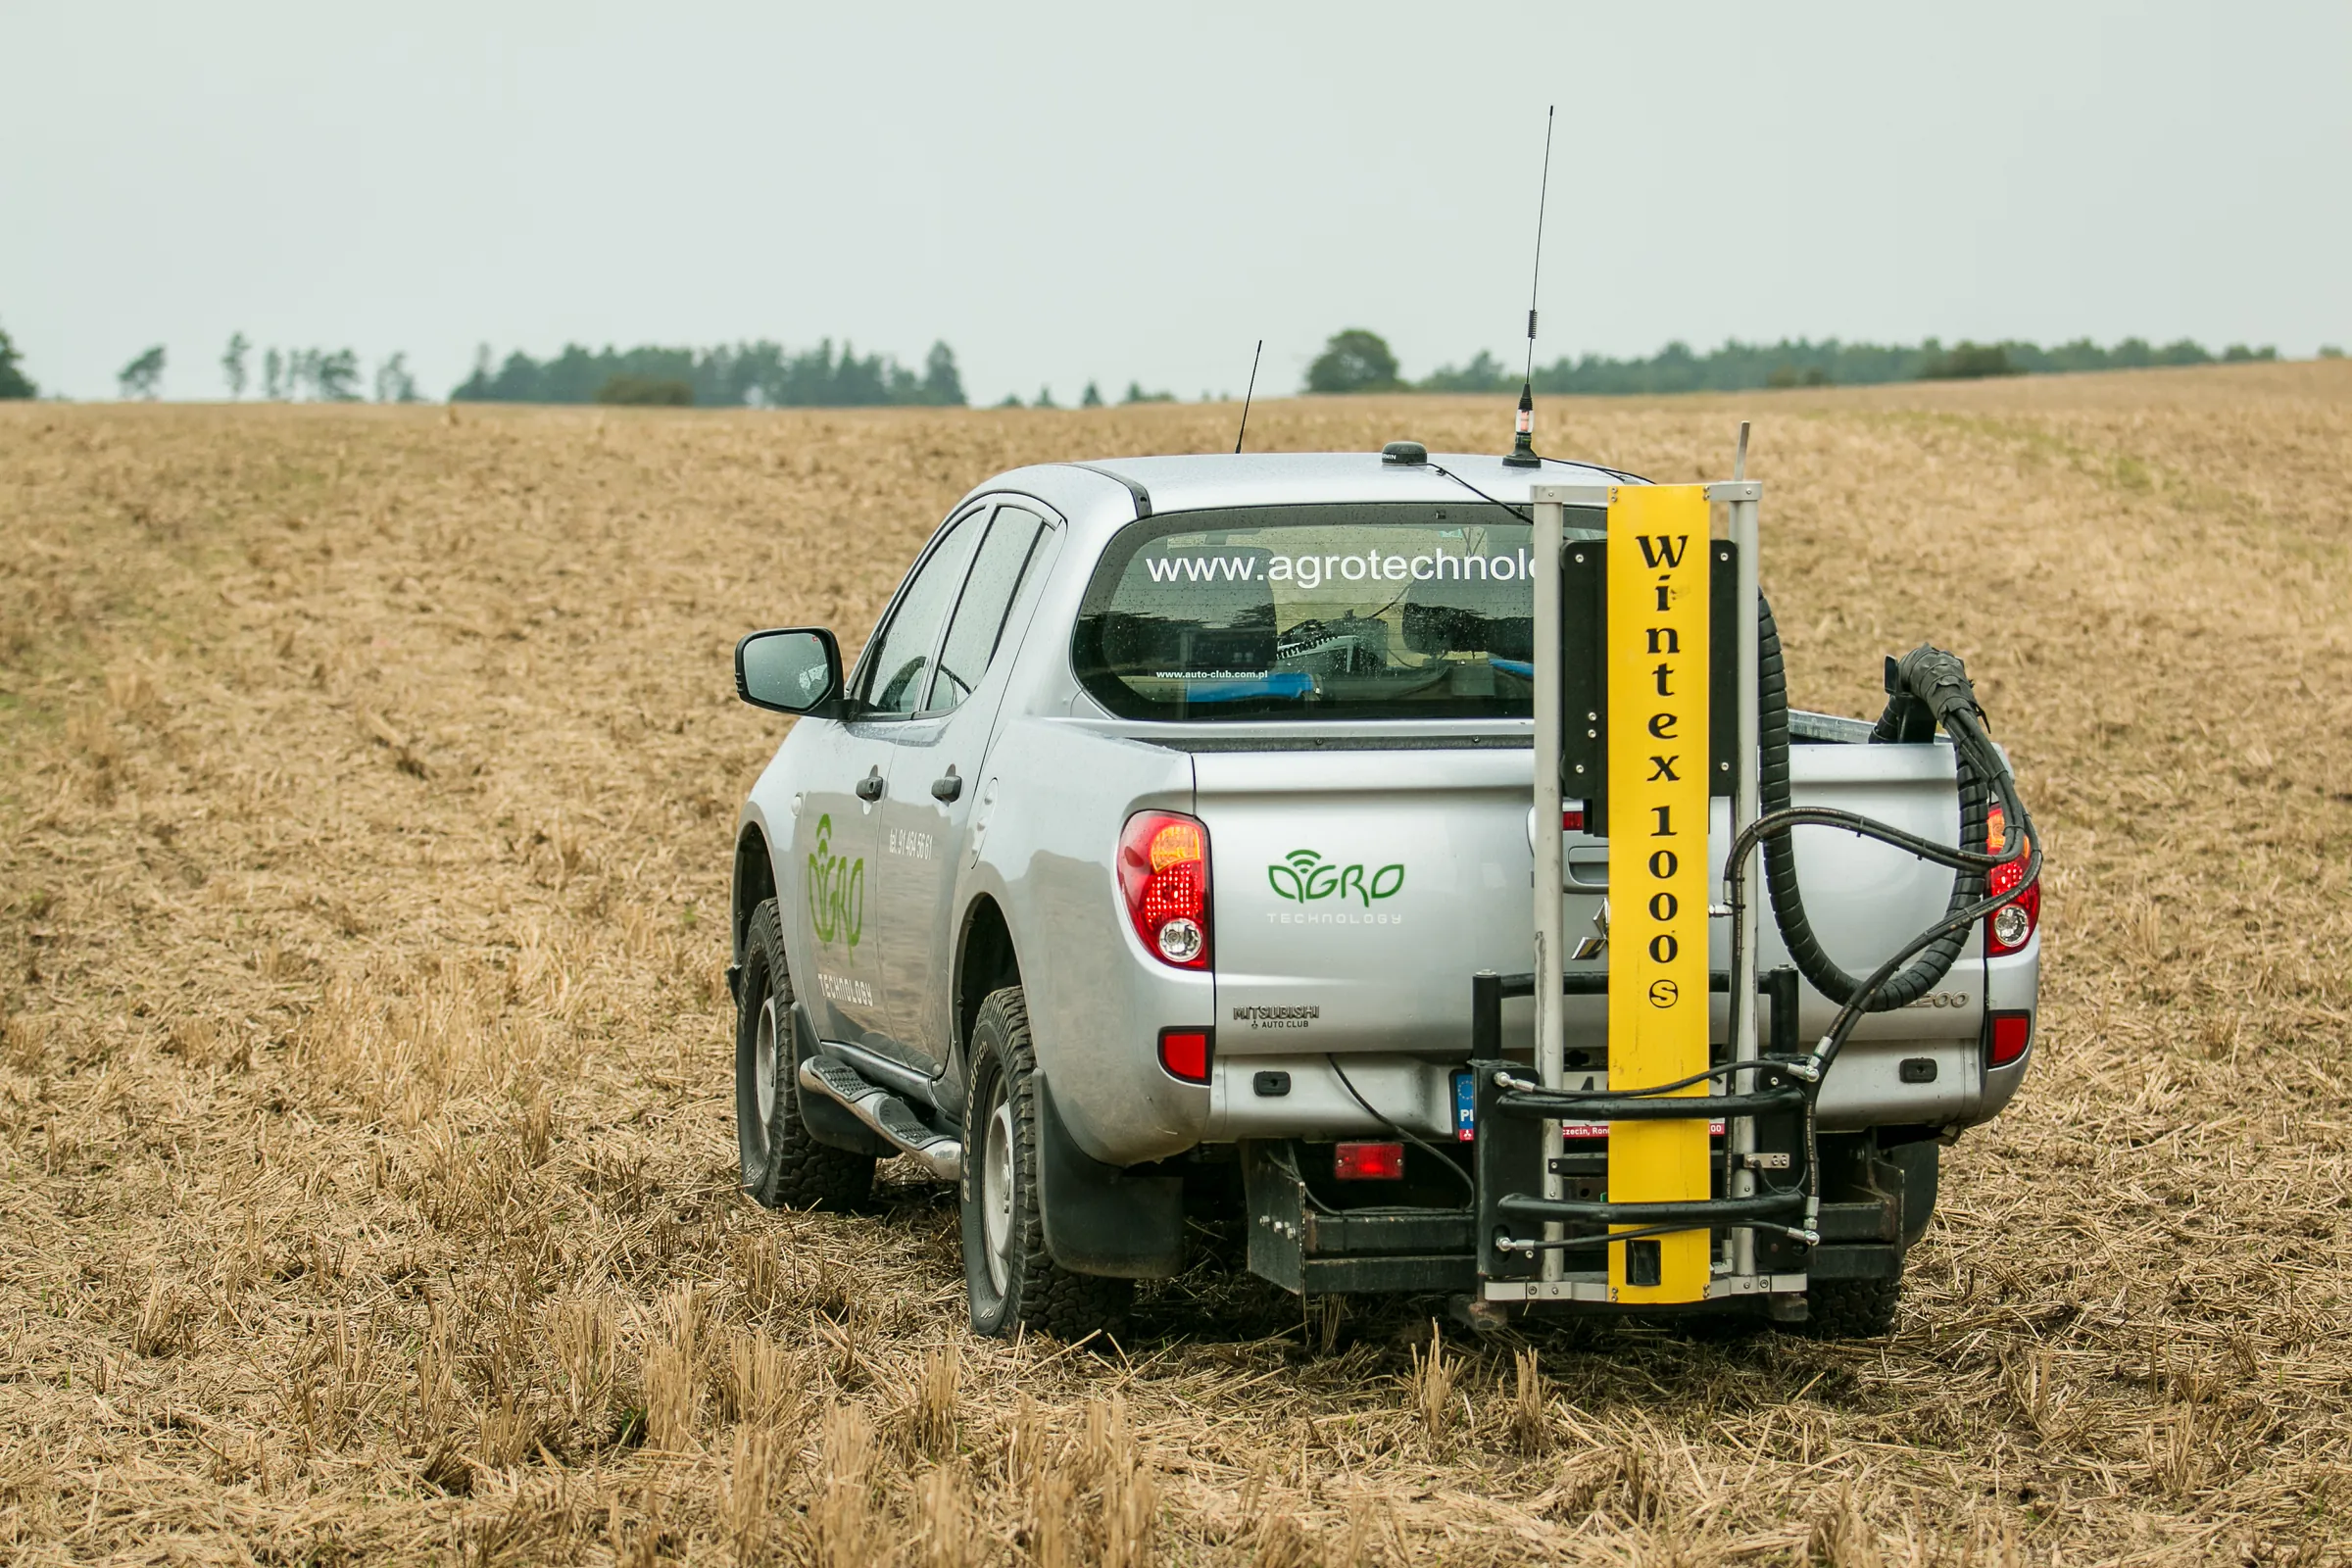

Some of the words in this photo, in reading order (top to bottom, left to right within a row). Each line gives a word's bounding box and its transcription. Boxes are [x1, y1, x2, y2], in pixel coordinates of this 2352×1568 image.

[1146, 548, 1536, 589] www.agrotechnol
[1155, 670, 1268, 680] www.auto-club.com.pl
[1635, 535, 1690, 782] Wintex
[1268, 863, 1404, 907] AGRO
[1266, 912, 1402, 924] TECHNOLOGY
[817, 973, 873, 1006] TECHNOLOGY
[1233, 1005, 1320, 1020] MITSUBISHI
